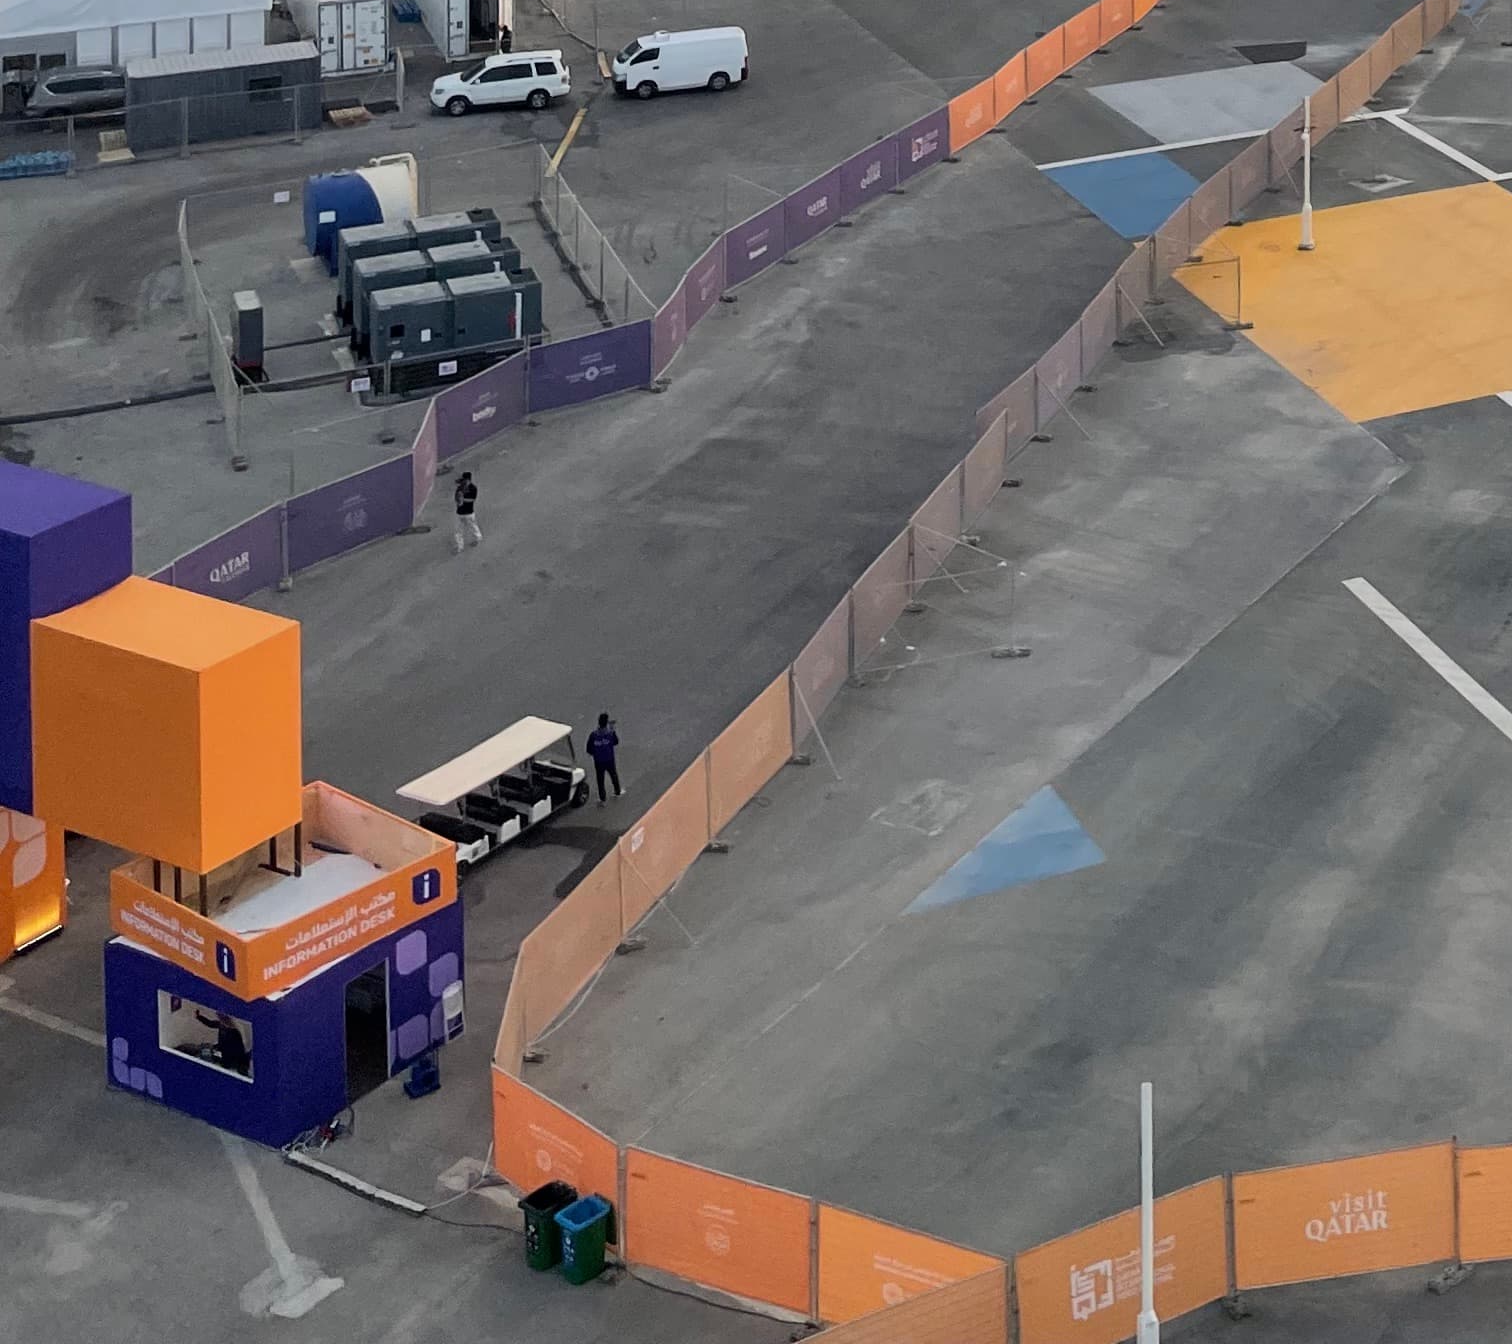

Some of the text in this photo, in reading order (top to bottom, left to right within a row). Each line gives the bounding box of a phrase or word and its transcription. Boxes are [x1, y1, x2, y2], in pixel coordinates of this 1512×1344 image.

[209, 552, 250, 582] QATAR
[262, 906, 396, 981] INFORMATION DESK
[1329, 1188, 1388, 1214] visit
[1304, 1210, 1389, 1243] QATAR
